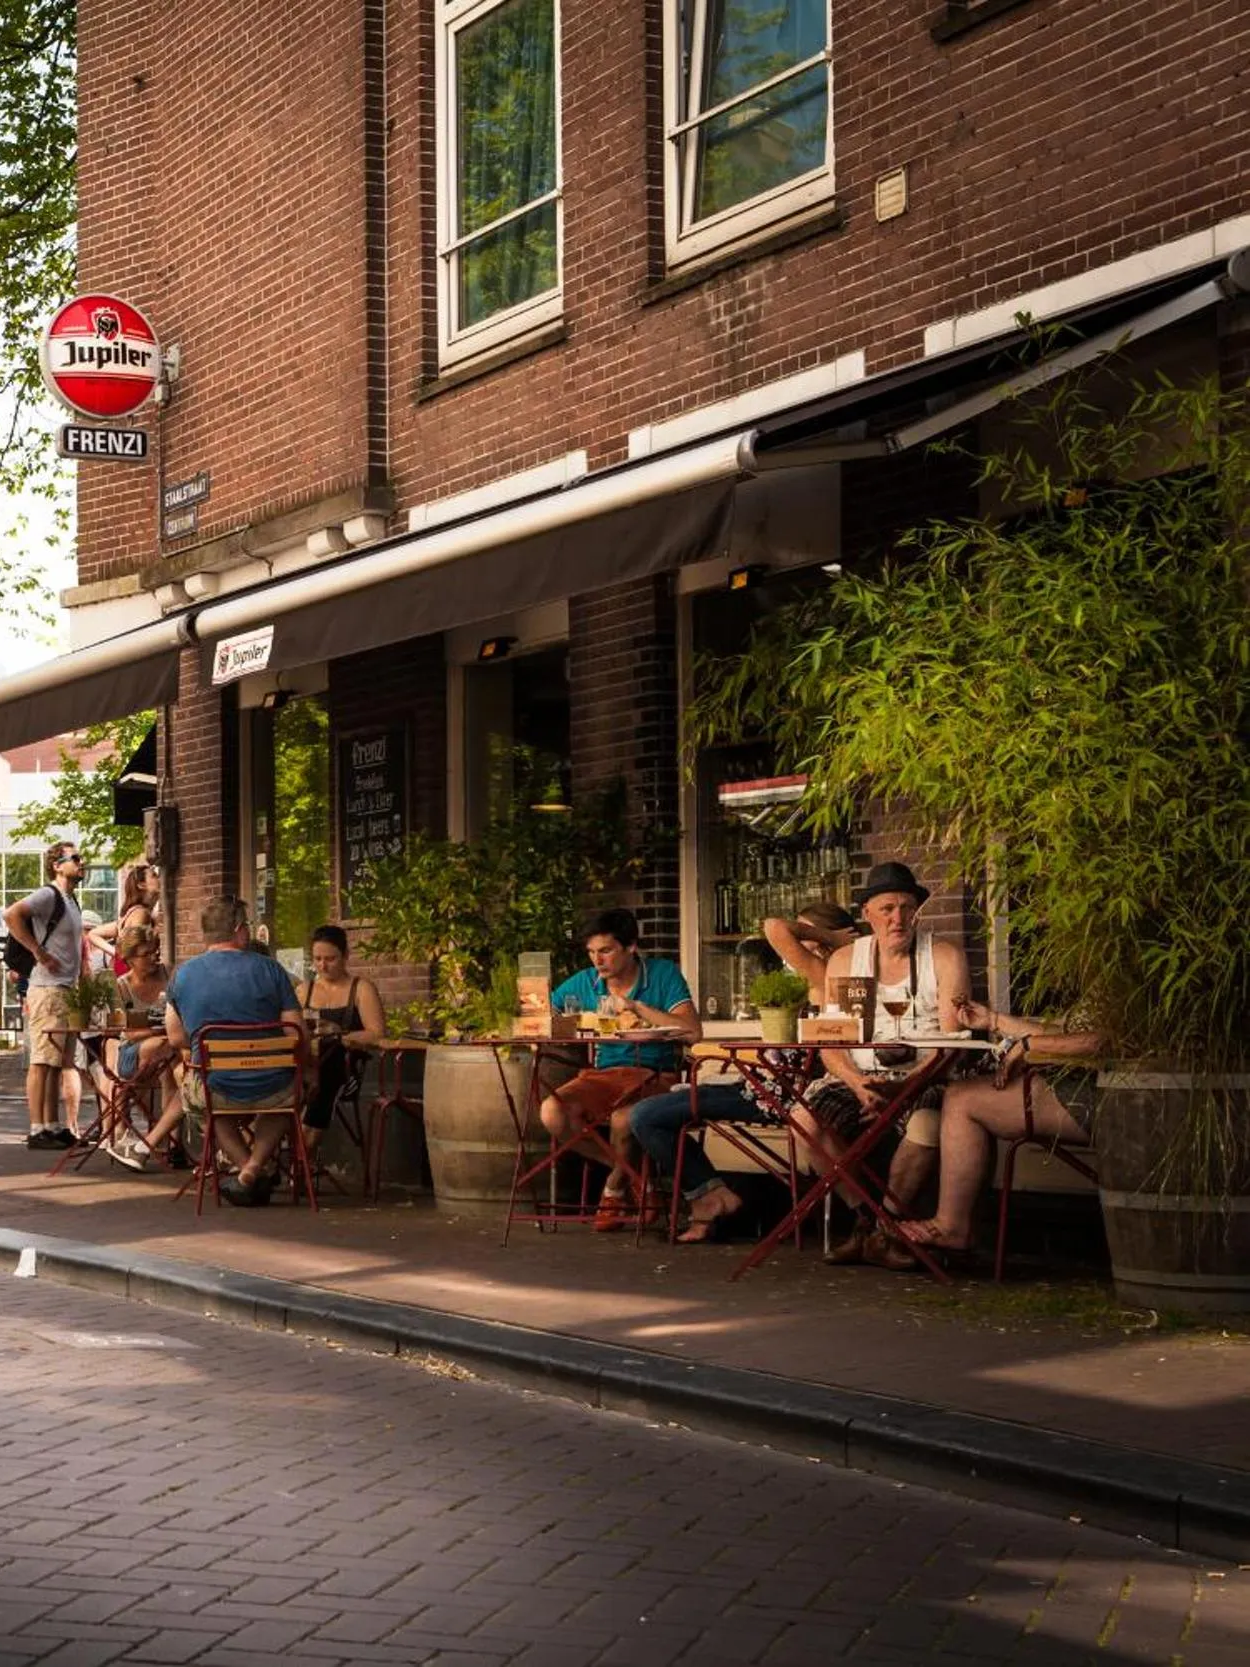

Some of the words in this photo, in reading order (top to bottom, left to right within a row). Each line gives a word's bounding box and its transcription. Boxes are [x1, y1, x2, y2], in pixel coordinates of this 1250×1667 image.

[60, 341, 152, 369] Jupiler
[67, 429, 143, 456] FRENZI
[230, 644, 269, 669] Jupiler
